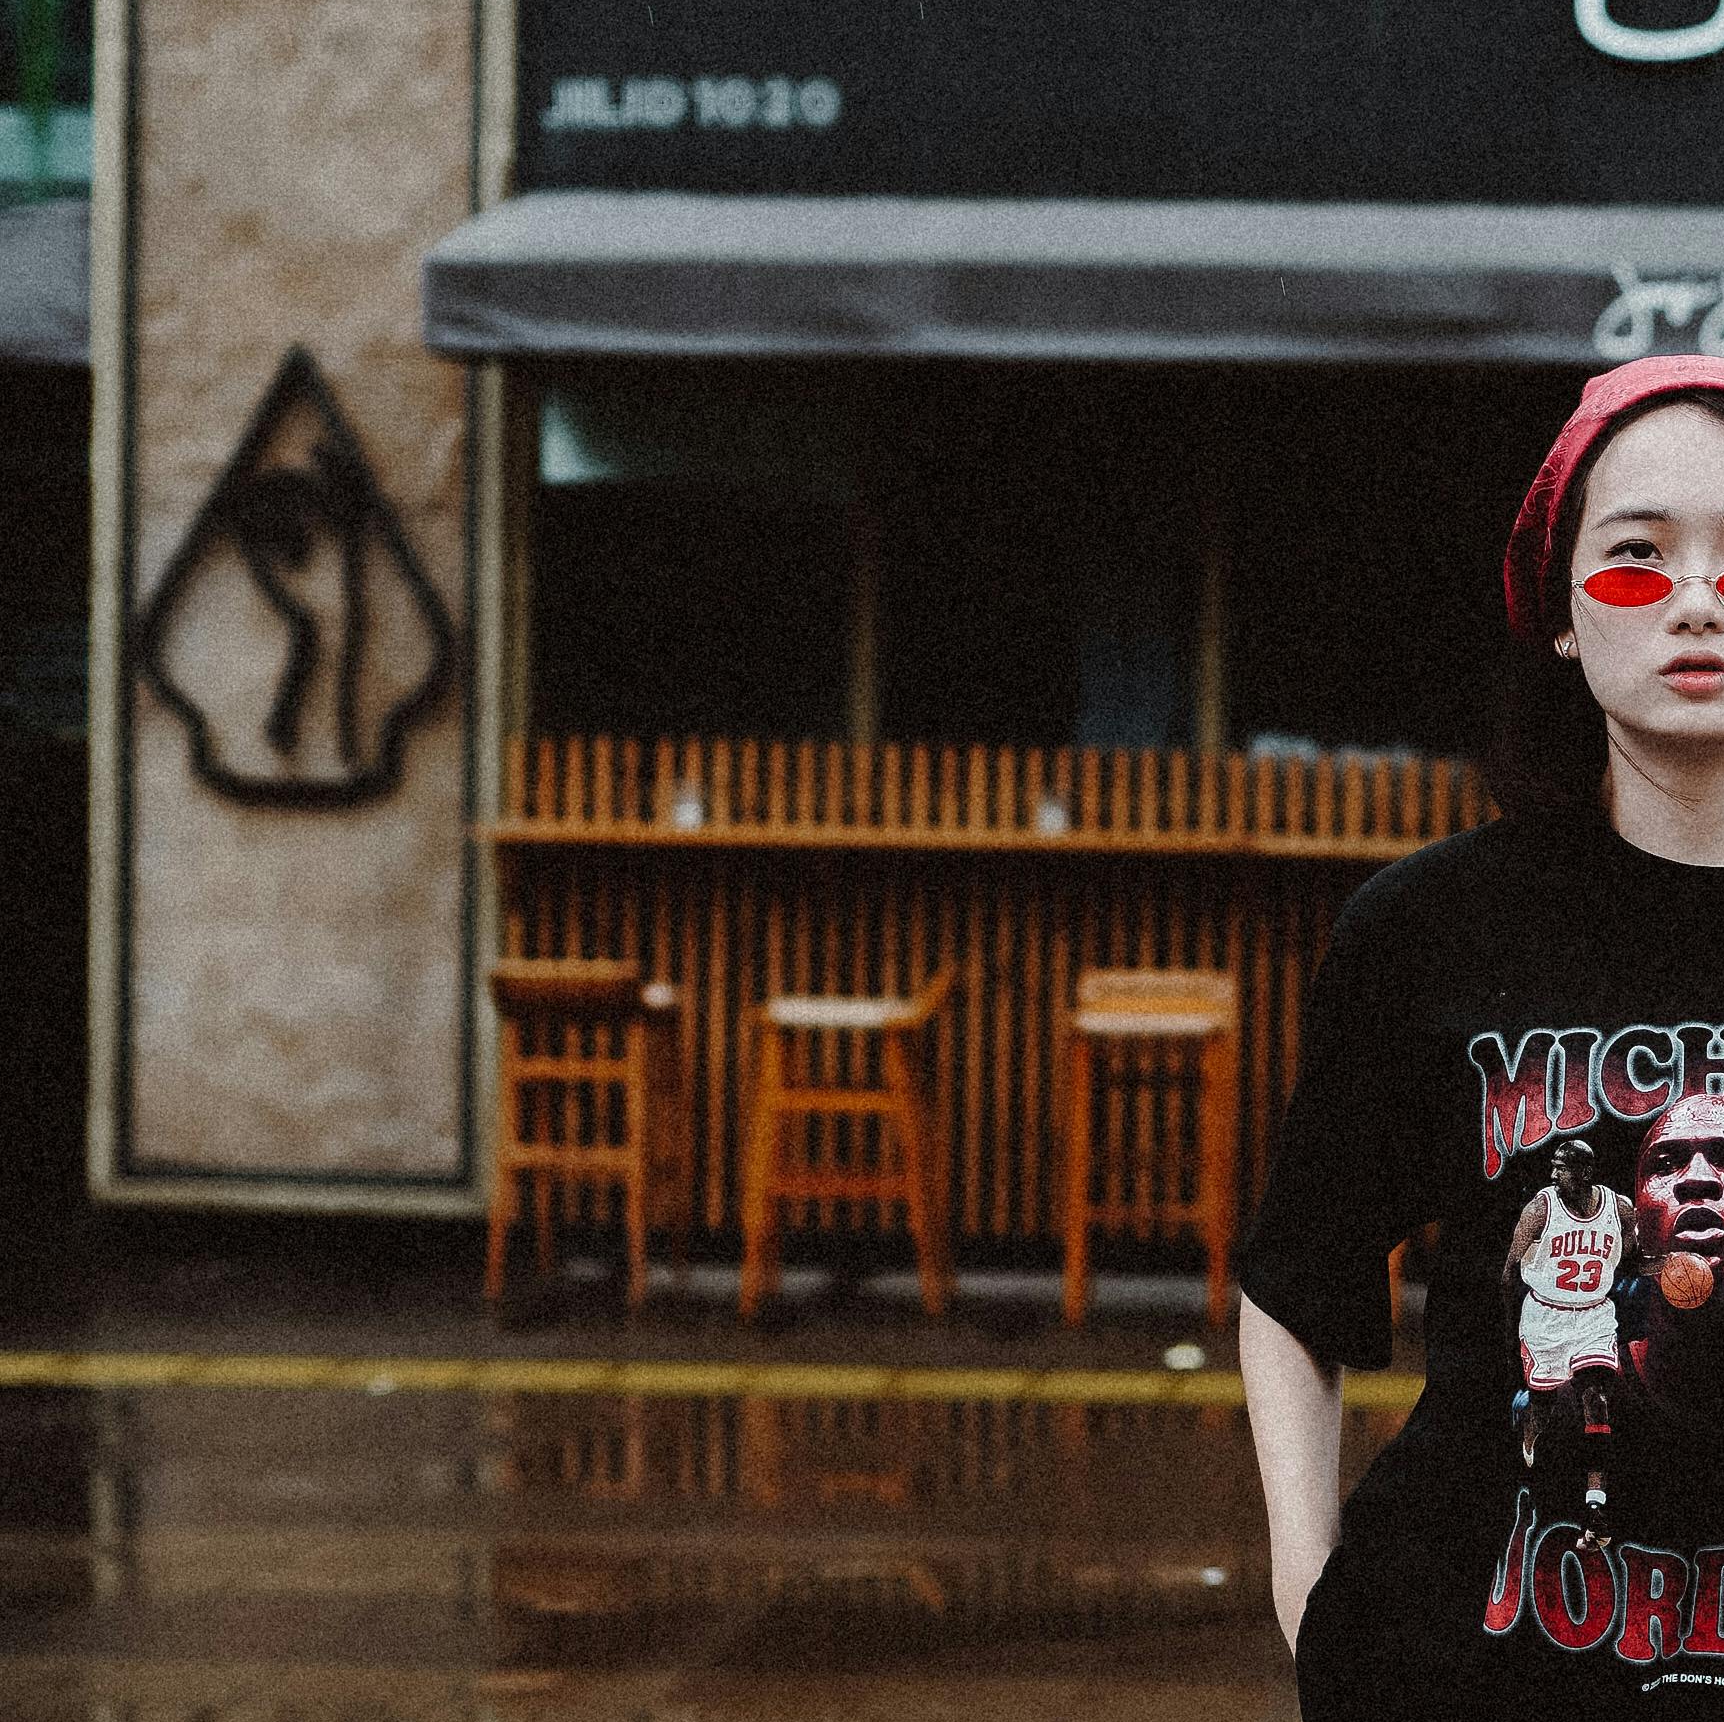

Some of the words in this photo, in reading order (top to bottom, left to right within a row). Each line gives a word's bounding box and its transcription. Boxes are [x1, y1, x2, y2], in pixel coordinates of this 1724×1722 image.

[1550, 1229, 1614, 1260] BULLS
[1555, 1259, 1604, 1293] 23
[1661, 1673, 1679, 1684] THE
[1679, 1673, 1713, 1685] DON'S
